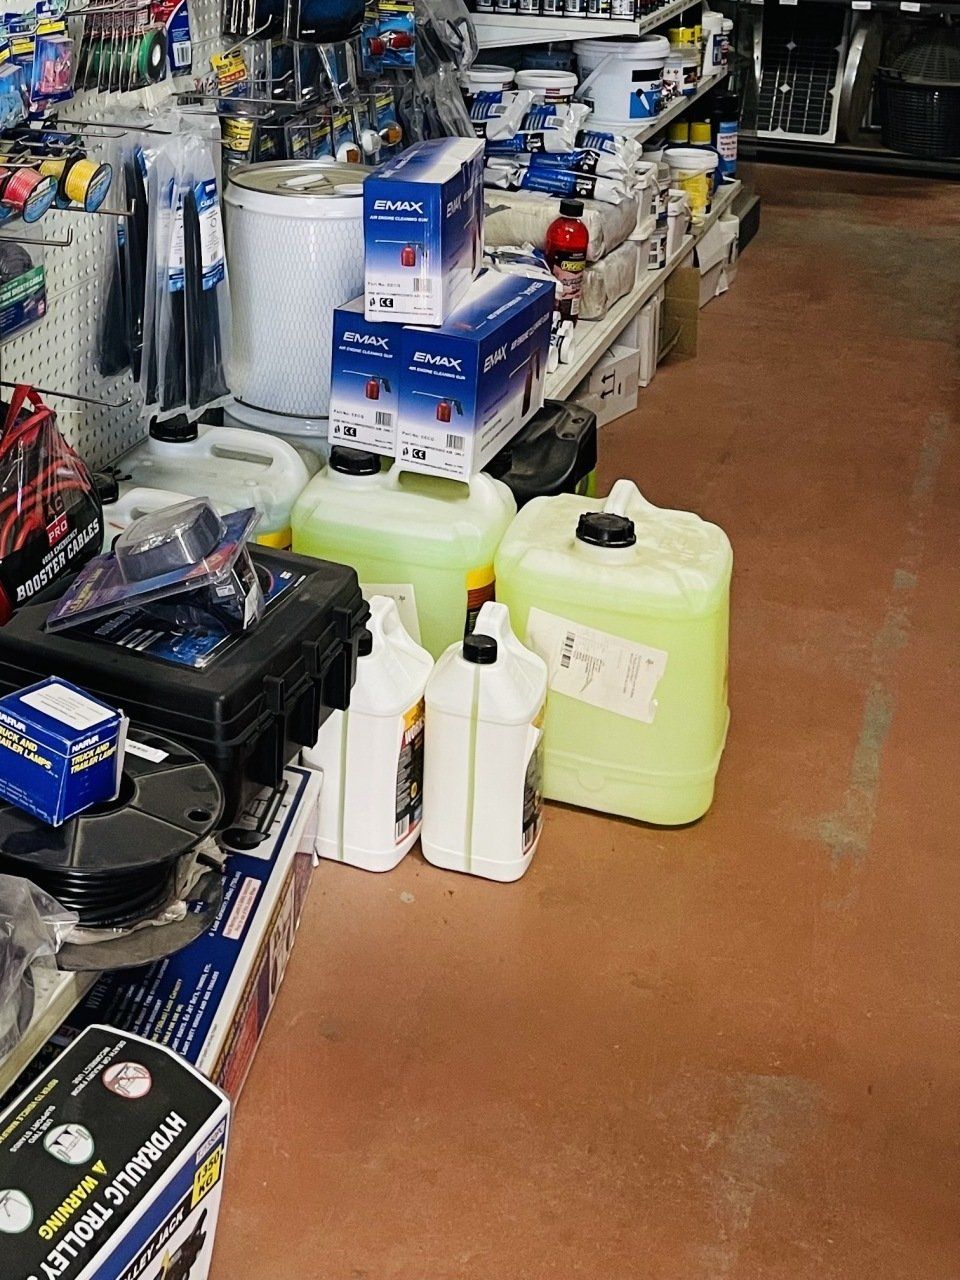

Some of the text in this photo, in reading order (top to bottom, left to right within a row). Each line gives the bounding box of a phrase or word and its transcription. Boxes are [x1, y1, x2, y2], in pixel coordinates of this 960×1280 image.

[374, 199, 423, 214] EMAX
[343, 331, 389, 350] EMAX
[413, 351, 462, 371] EMAX
[484, 342, 507, 373] EMAX
[48, 520, 68, 543] PRO
[16, 518, 100, 602] BOOSTER CABLES
[21, 738, 38, 752] AND
[71, 742, 110, 766] TRUCK AND
[72, 735, 99, 753] NARVA
[24, 749, 52, 770] LAMPS
[71, 756, 98, 774] TRAILER
[8, 1103, 57, 1154] SUPPORT STANDS
[26, 1129, 43, 1145] TWO
[104, 1111, 188, 1206] HYDRAULIC
[198, 1176, 214, 1195] KG
[38, 1175, 99, 1241] WARNING
[156, 1208, 185, 1245] JACK
[40, 1201, 114, 1278] TROLLEY
